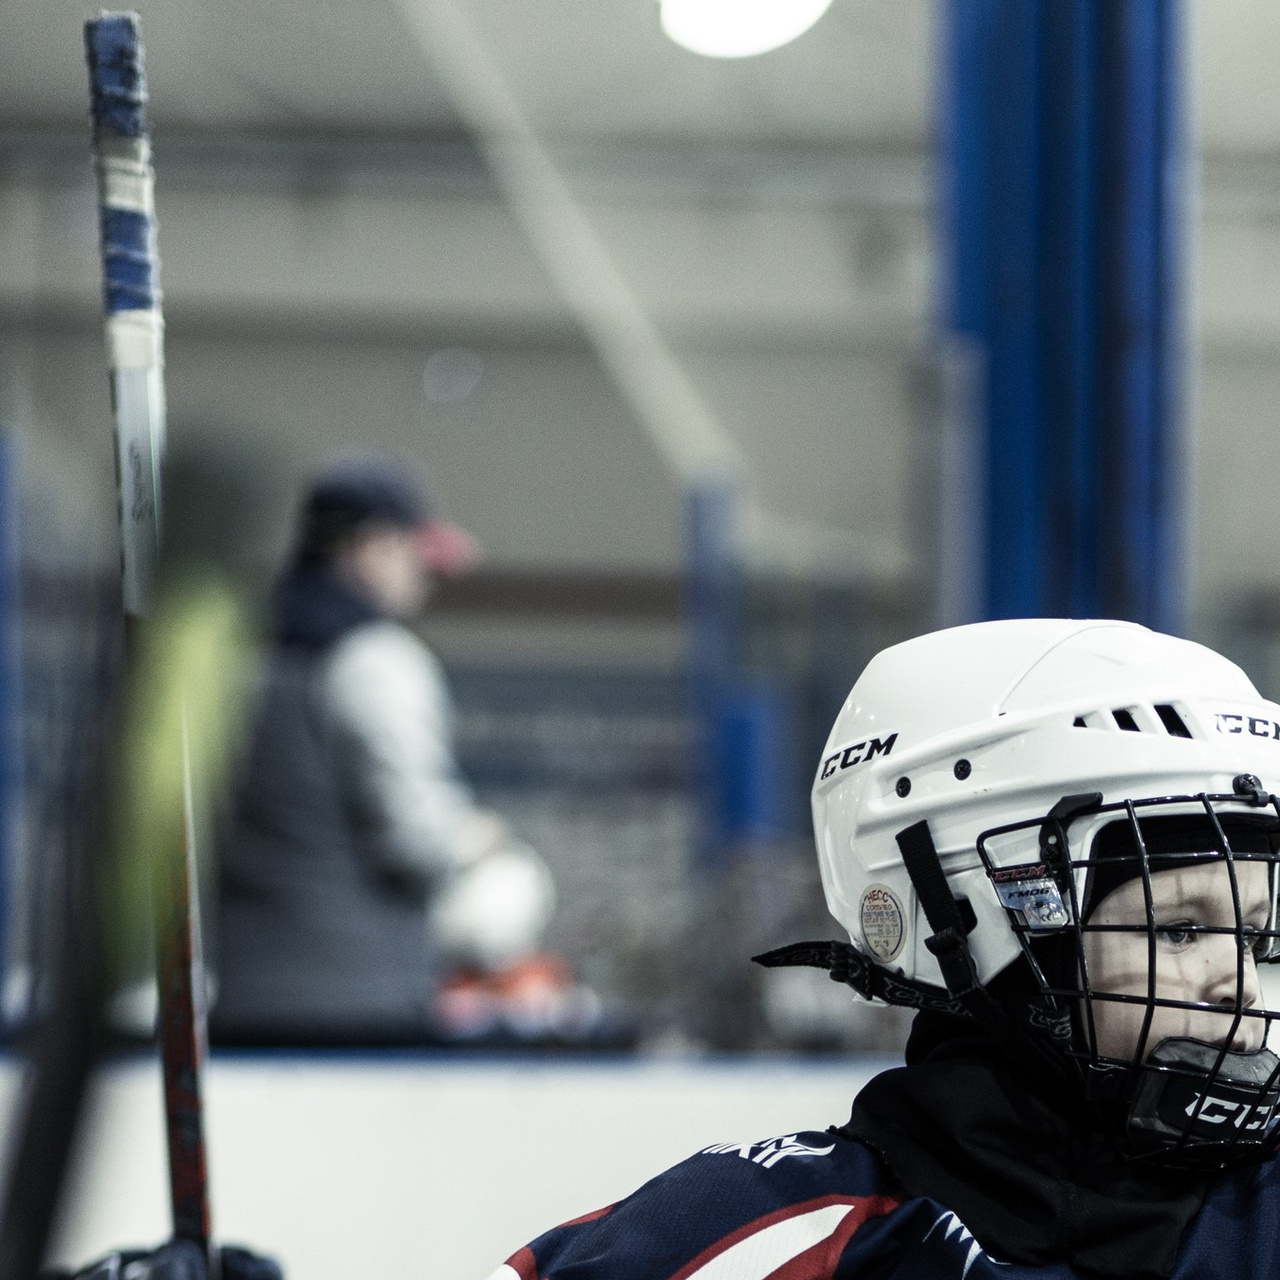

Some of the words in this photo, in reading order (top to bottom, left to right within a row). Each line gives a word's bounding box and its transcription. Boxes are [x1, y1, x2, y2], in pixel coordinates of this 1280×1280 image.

[820, 732, 899, 780] CCM
[994, 865, 1046, 881] CCM
[1184, 1091, 1276, 1132] CC
